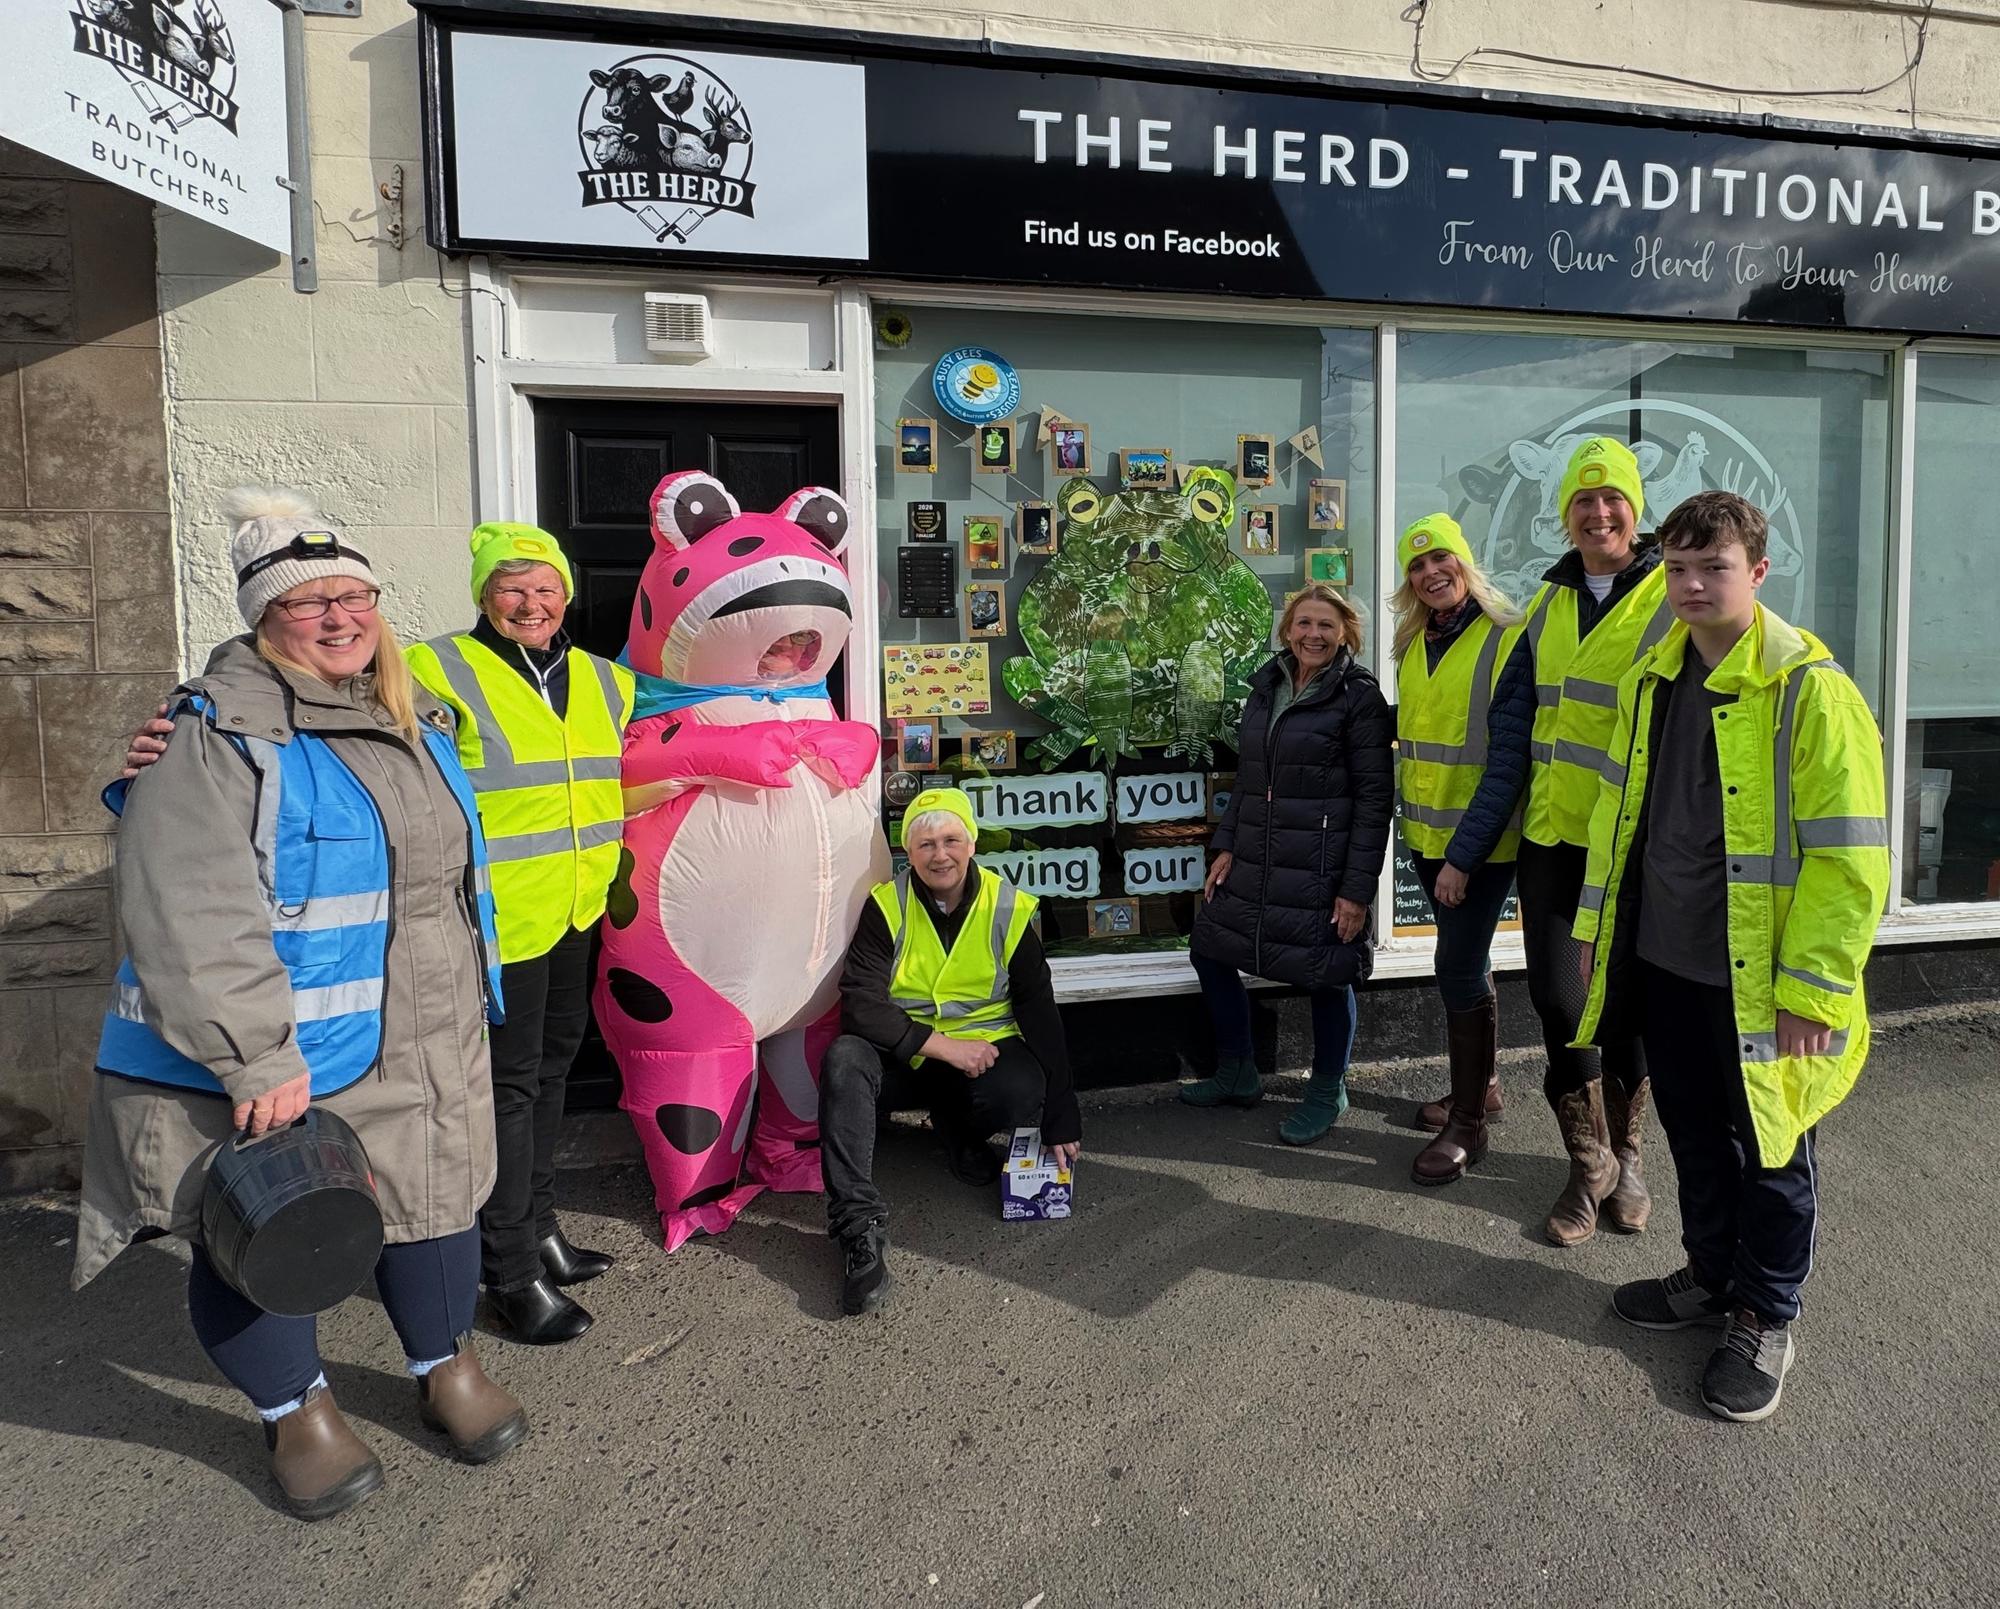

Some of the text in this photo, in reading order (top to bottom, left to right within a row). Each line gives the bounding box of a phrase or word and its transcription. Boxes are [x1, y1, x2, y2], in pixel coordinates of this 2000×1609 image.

[79, 19, 231, 121] THE HERD
[64, 91, 248, 193] TRADITIONAL
[92, 140, 230, 216] BUTCHERS
[587, 172, 744, 208] THE HERD
[1018, 109, 1172, 173] THE
[1213, 125, 1410, 189] HERD
[1500, 149, 1944, 232] TRADITIONAL
[1025, 220, 1281, 257] Find us on Facebook
[1438, 220, 1534, 270] From
[1548, 230, 1619, 274] Our
[1726, 242, 1765, 284] To
[1776, 245, 1860, 290] Your
[1869, 251, 1953, 296] Home
[937, 349, 982, 381] BUSY BEES
[989, 370, 1019, 419] SEAHOUSES
[965, 780, 1198, 818] Thank you
[1128, 856, 1197, 885] our
